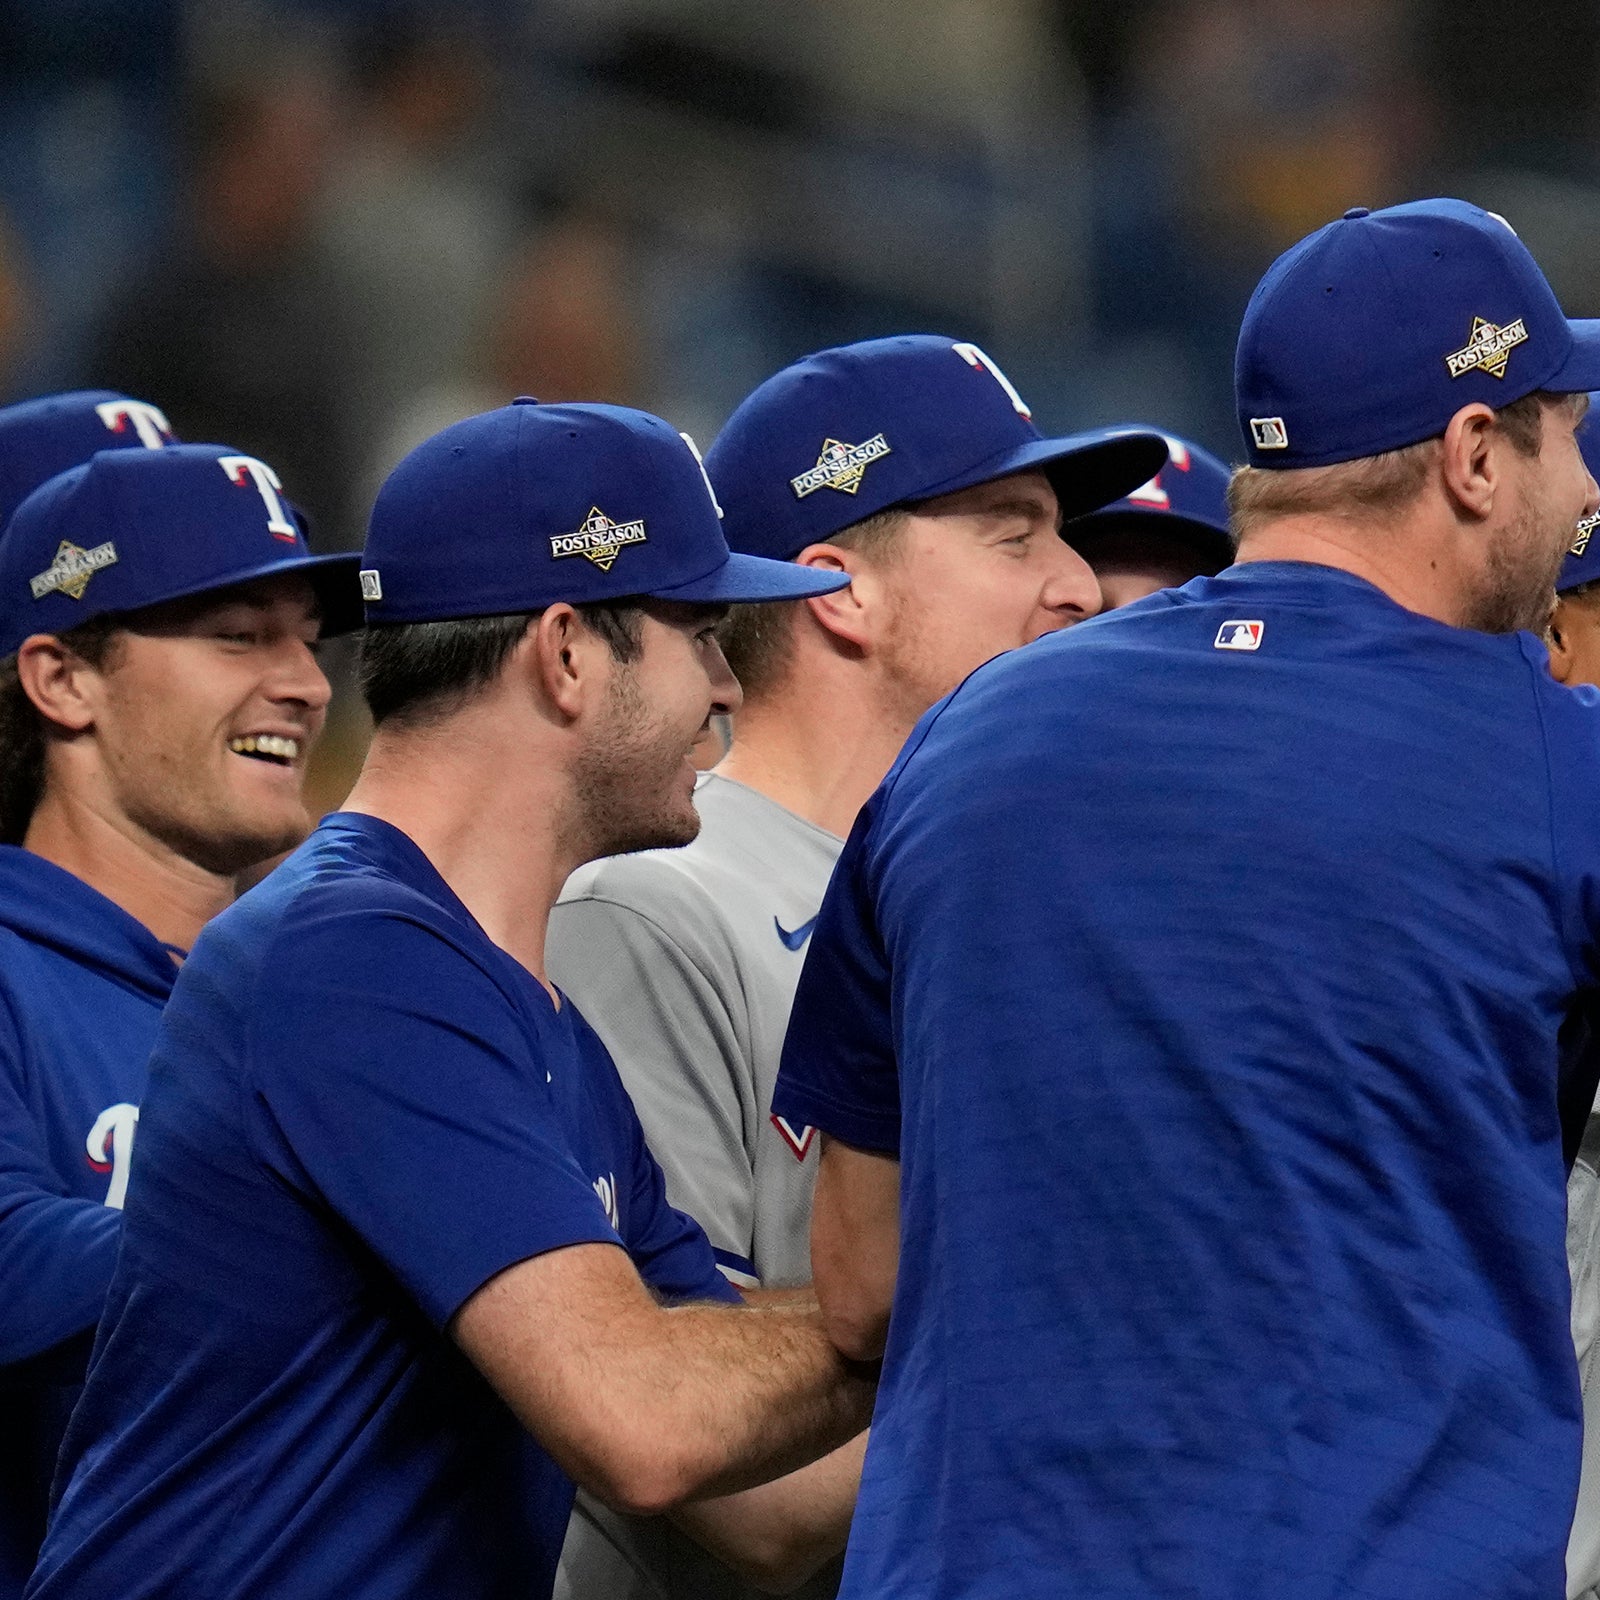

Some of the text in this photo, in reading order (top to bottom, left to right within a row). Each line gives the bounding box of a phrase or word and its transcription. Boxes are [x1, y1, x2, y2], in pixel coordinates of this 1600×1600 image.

[1447, 321, 1527, 376] POSTSEASON
[793, 437, 889, 496] POSTSEASON
[217, 455, 297, 544] T
[551, 522, 646, 558] POSTSEASON
